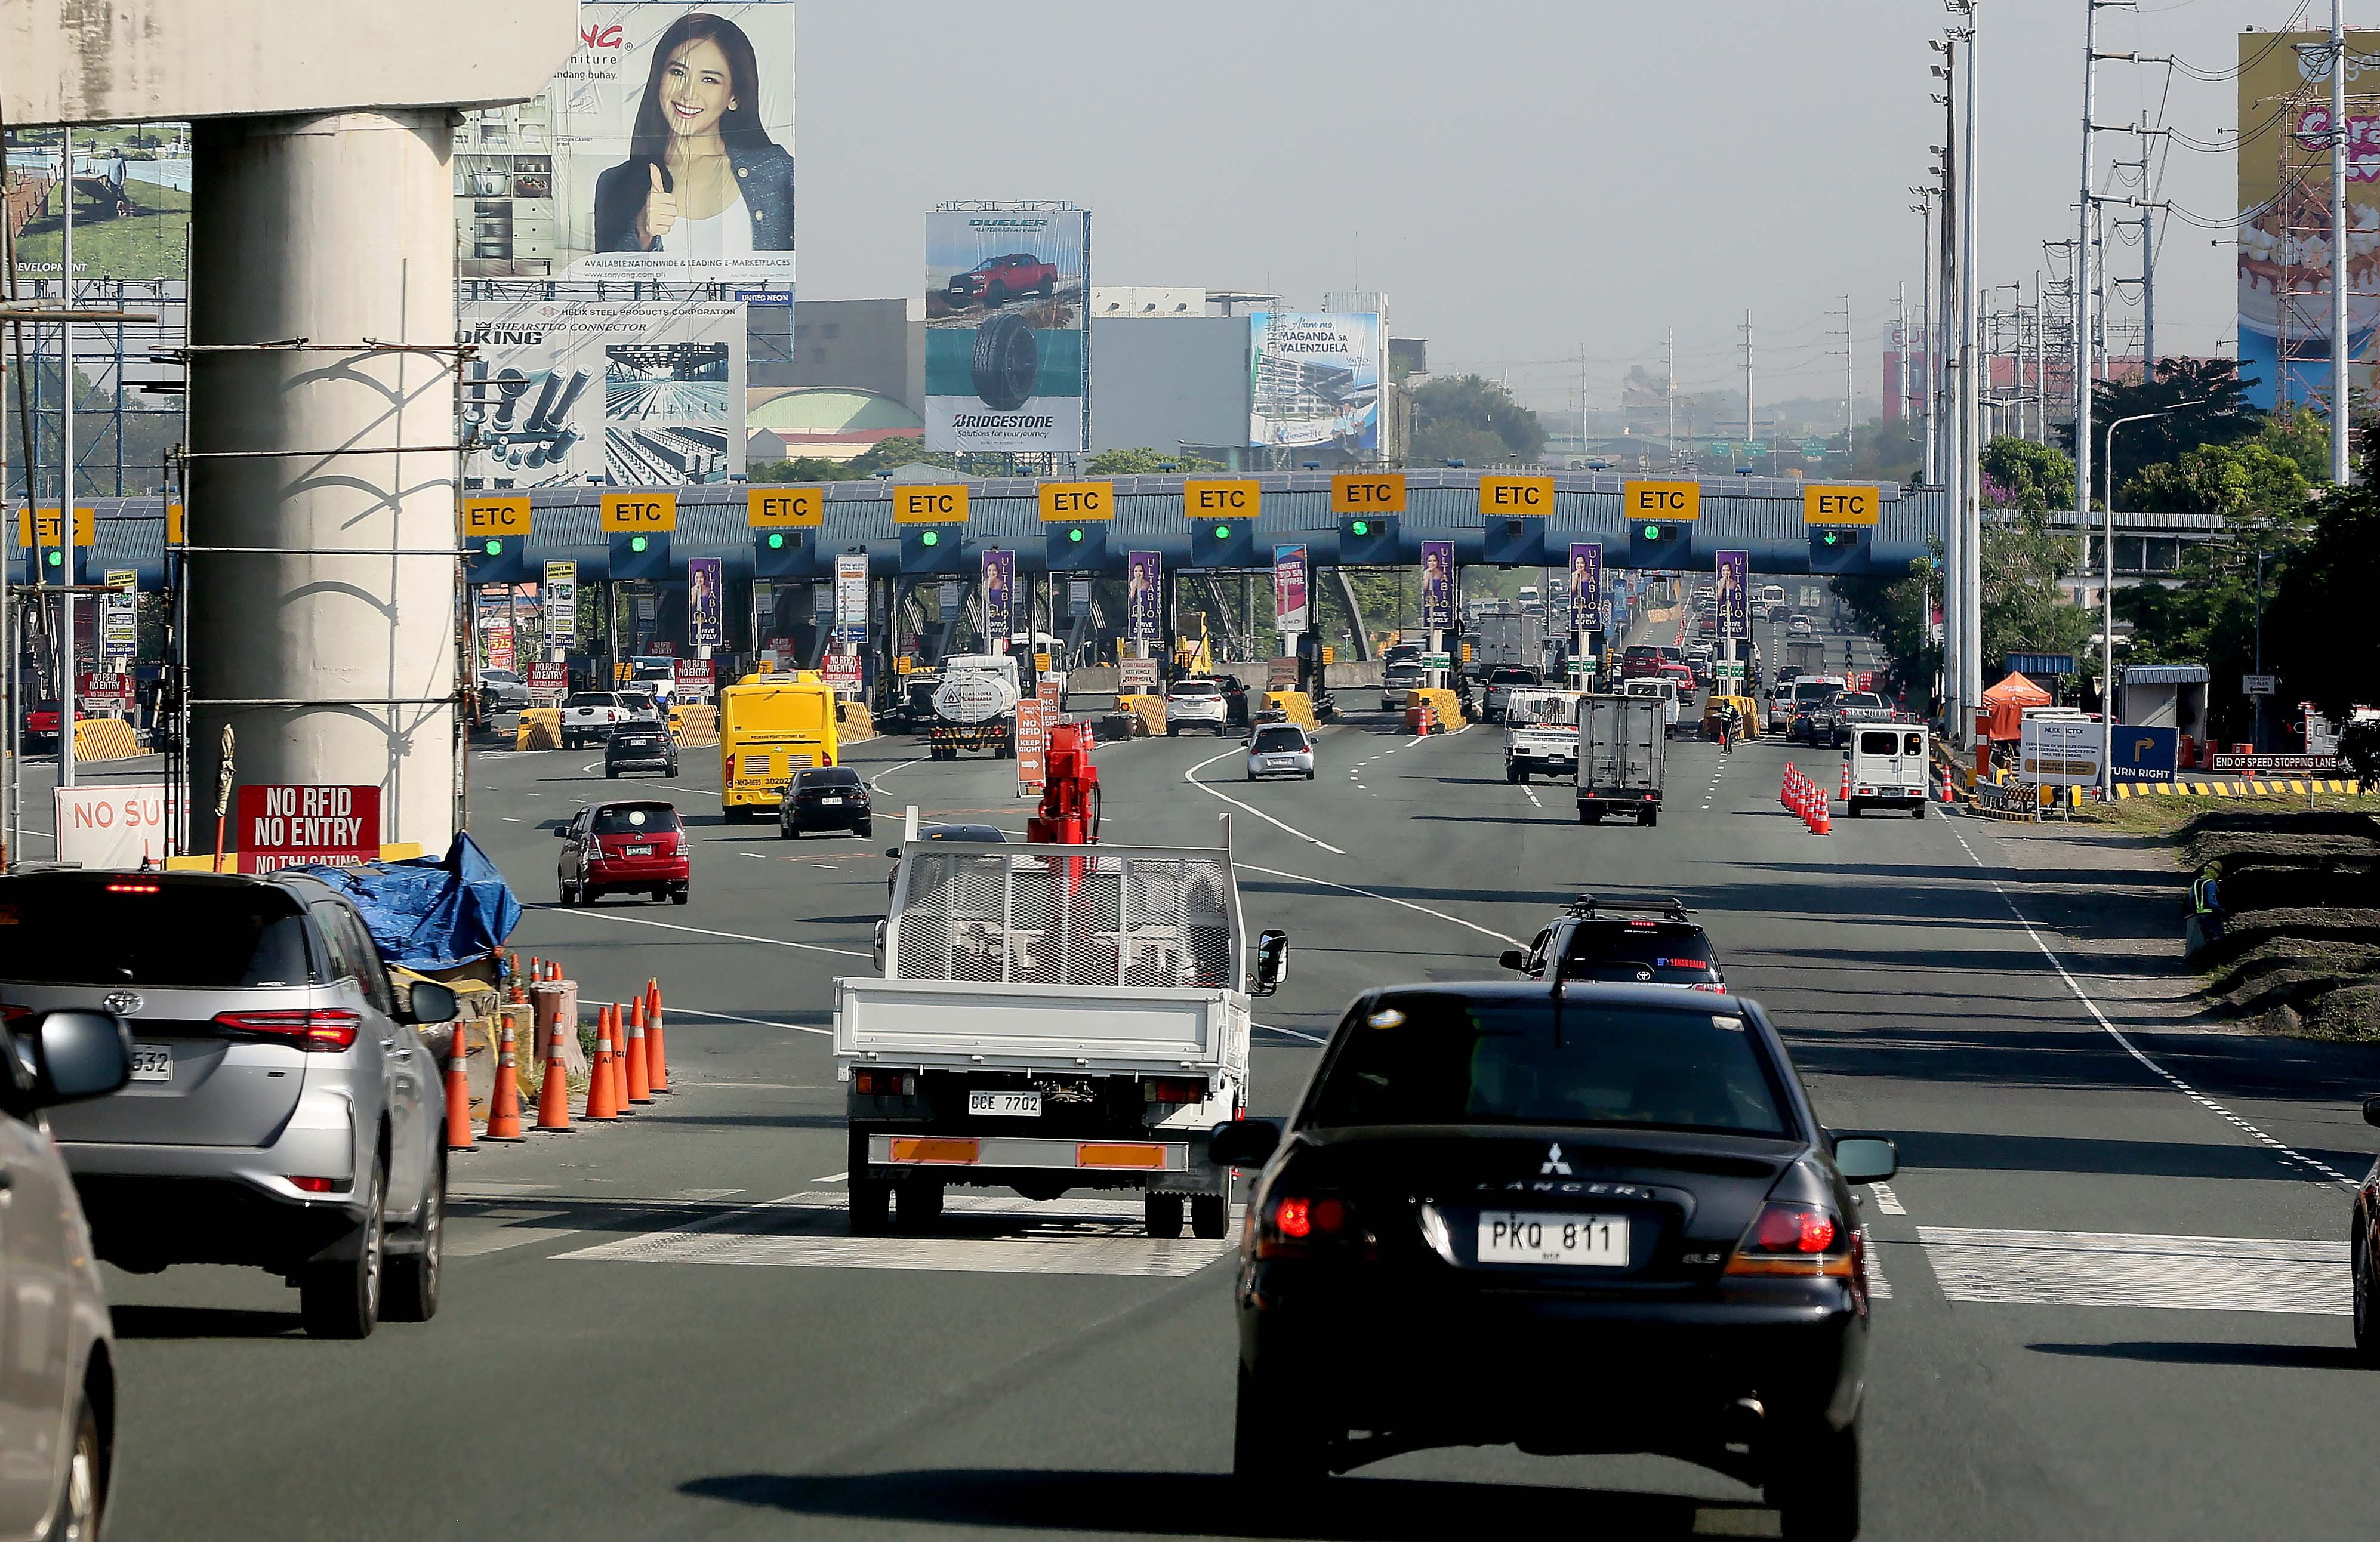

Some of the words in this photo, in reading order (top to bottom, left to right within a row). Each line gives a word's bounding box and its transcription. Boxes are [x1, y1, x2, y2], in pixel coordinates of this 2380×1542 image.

[554, 71, 585, 81] ndang
[588, 70, 618, 81] buhay.
[494, 322, 566, 332] SHEARSTUD
[569, 322, 647, 331] CONNECTOR
[952, 414, 1053, 428] BRIDGESTONE
[1055, 492, 1099, 510] ETC
[1201, 491, 1244, 507] ETC
[1348, 485, 1391, 502] ETC
[1496, 487, 1539, 504] ETC
[1641, 492, 1684, 509] ETC
[764, 499, 807, 516] ETC
[910, 495, 953, 513] ETC
[1820, 496, 1864, 514] ETC
[472, 508, 515, 526] ETC
[617, 504, 660, 521] ETC
[535, 662, 544, 671] NO
[545, 662, 560, 671] RFID
[683, 659, 691, 668] NO
[692, 659, 707, 668] RFID
[93, 673, 101, 681] NO
[532, 671, 541, 679] NO
[542, 671, 562, 680] ENTRY
[689, 668, 710, 677] ENTRY
[90, 681, 98, 690] NO
[100, 681, 120, 690] ENTRY
[1846, 708, 1890, 717] SECURITY
[1019, 727, 1041, 736] RFID
[2216, 757, 2233, 767] END
[2235, 757, 2245, 767] OF
[2247, 757, 2273, 767] SPEED
[2274, 757, 2314, 767] STOPPING
[2316, 757, 2336, 767] LANE
[2139, 769, 2171, 779] RIGHT
[267, 788, 296, 816] NO
[303, 788, 352, 816] RFID
[75, 801, 113, 828] NO
[255, 817, 285, 846] NO
[291, 818, 362, 846] ENTRY
[255, 855, 276, 874] NO
[133, 1052, 168, 1072] 532
[1005, 1097, 1038, 1111] 7702
[1477, 1180, 1636, 1195] LANCER
[1493, 1221, 1542, 1249] PKQ
[1564, 1223, 1610, 1251] 811
